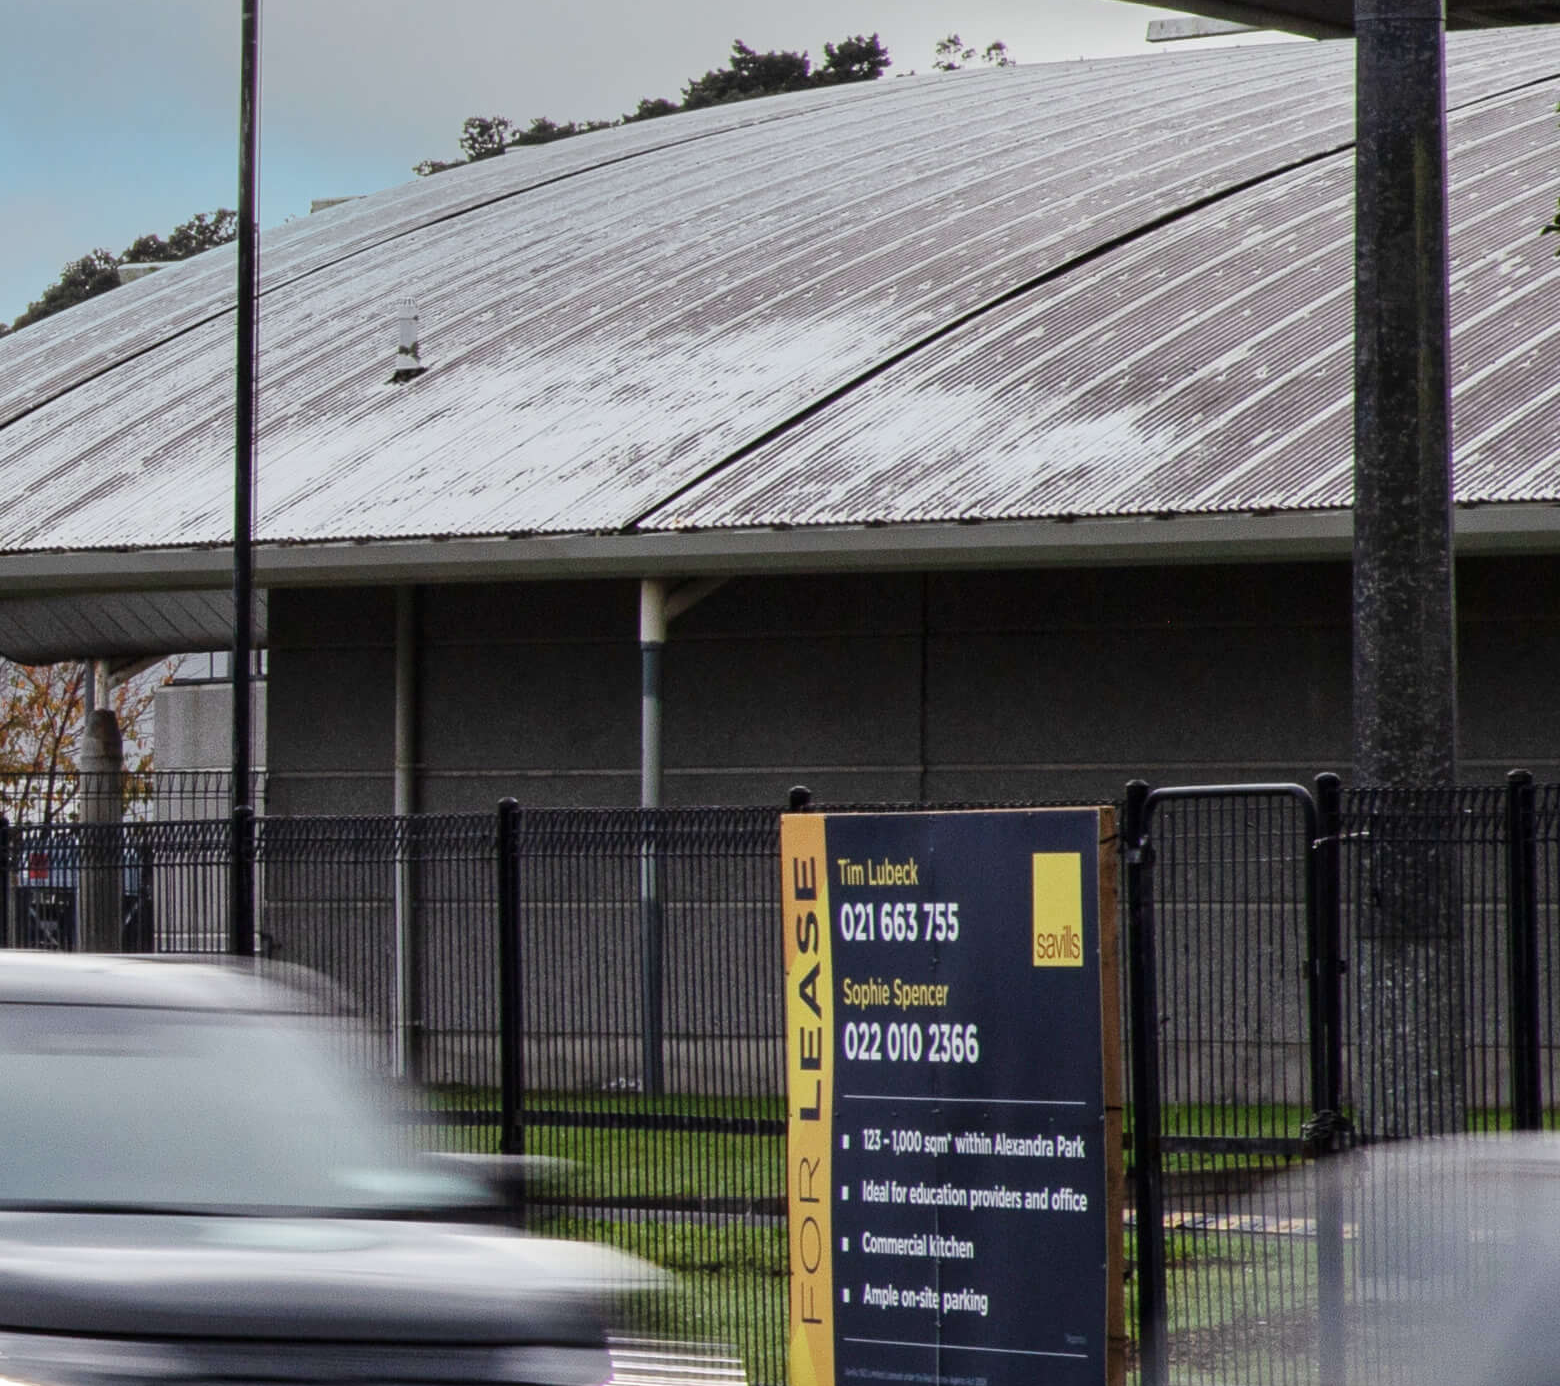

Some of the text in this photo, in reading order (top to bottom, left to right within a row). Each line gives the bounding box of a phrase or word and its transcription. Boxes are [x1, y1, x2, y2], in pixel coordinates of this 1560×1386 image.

[837, 857, 919, 886] Tim Lubeck
[841, 903, 960, 941] 021 663 755
[1036, 925, 1080, 959] savills
[843, 978, 949, 1011] Sophie Spencer
[844, 1022, 979, 1063] 022 010 2366
[793, 856, 823, 1325] FOR LEASE
[863, 1128, 881, 1151] 123
[891, 1130, 921, 1155] 1,000
[955, 1131, 992, 1155] within
[994, 1132, 1054, 1157] Alexandra
[1057, 1134, 1086, 1158] Park
[862, 1180, 1088, 1212] Ideal for education providers and office
[862, 1231, 974, 1259] Commercial kitchen
[863, 1283, 988, 1317] Ample on-site parking
